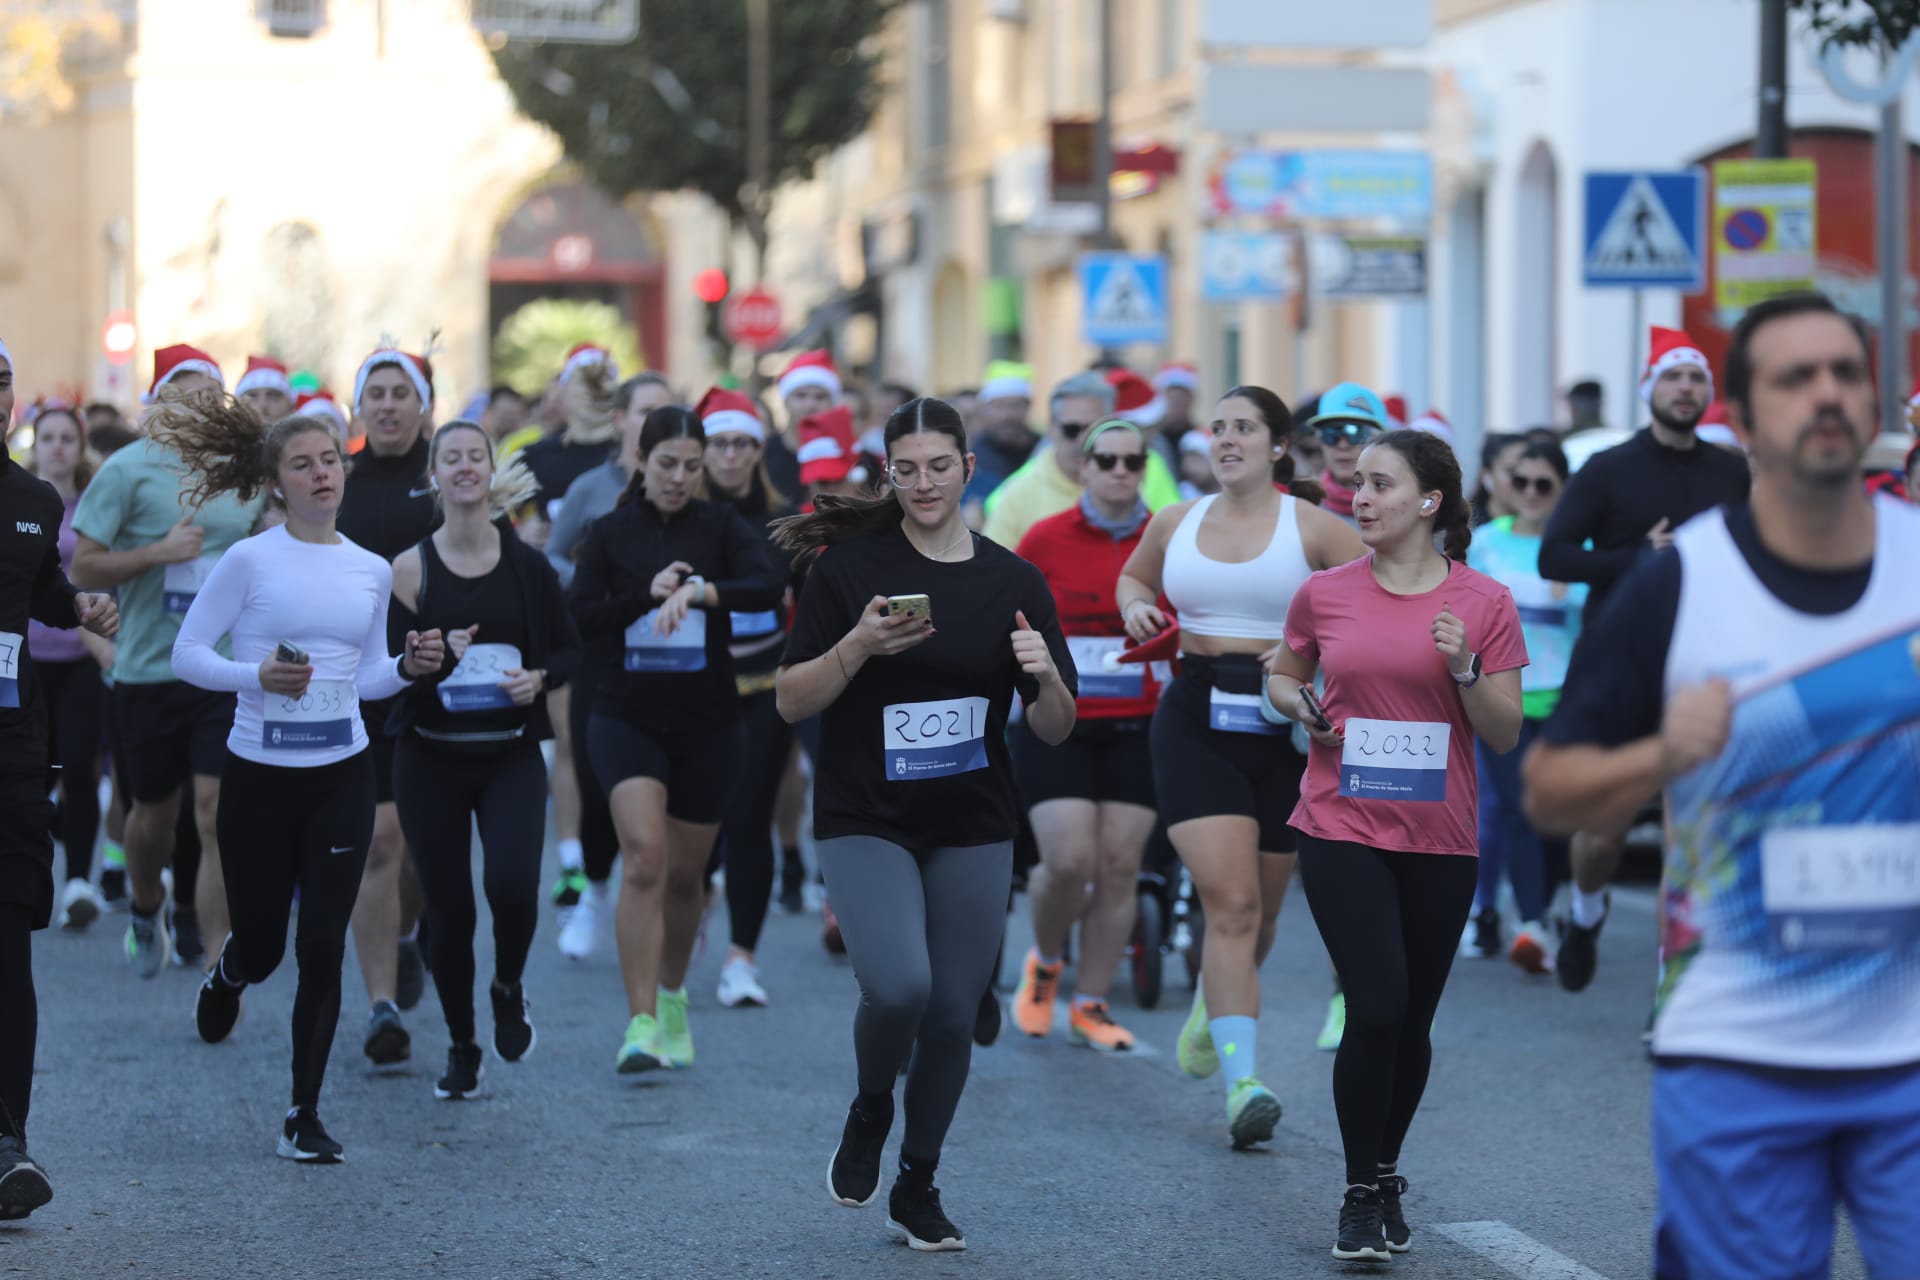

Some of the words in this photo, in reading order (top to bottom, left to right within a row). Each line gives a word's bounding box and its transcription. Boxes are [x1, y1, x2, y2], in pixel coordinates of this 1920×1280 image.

[16, 521, 42, 535] NASA
[895, 706, 973, 742] 2021
[1359, 730, 1437, 756] 2022
